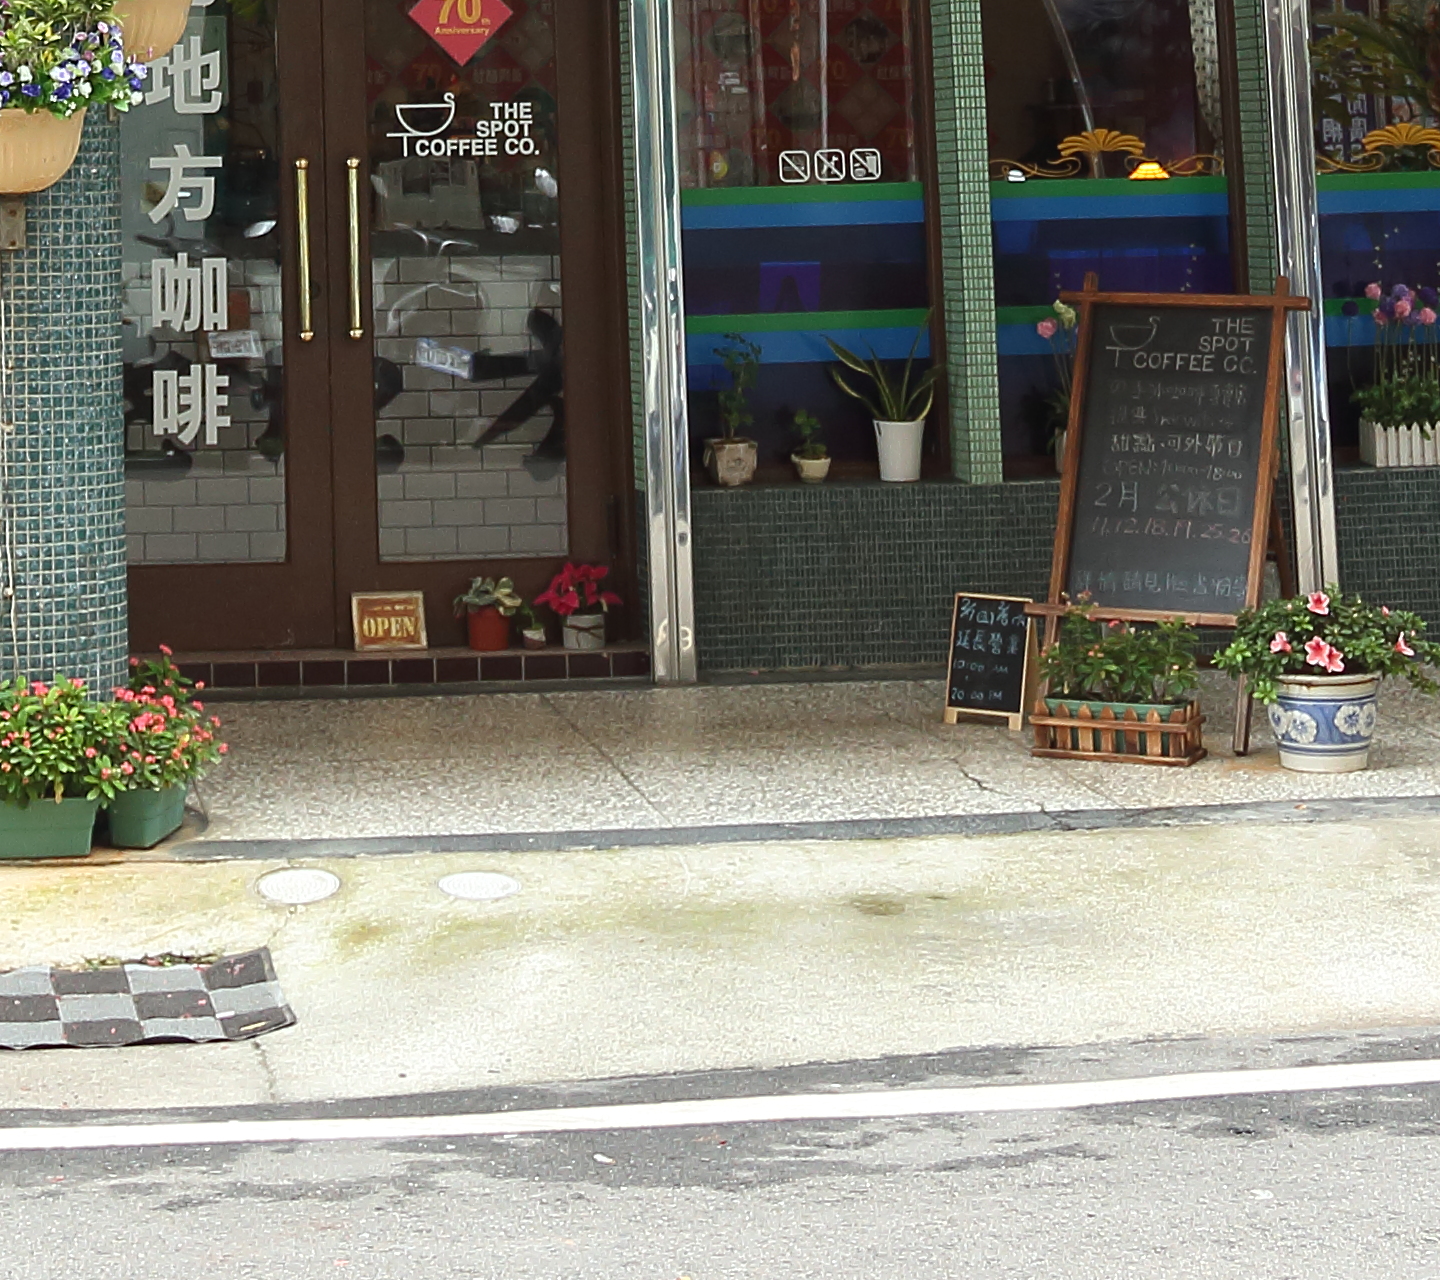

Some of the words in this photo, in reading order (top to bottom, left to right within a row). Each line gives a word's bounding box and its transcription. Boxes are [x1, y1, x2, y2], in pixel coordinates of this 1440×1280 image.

[434, 26, 490, 36] Anniversary
[489, 102, 532, 119] THE
[476, 120, 532, 137] SPOT
[415, 139, 498, 156] COFFEE
[504, 138, 540, 155] CO.
[1212, 317, 1255, 335] THE
[1199, 336, 1255, 353] SPOT
[1133, 351, 1216, 372] COFFEE
[362, 615, 416, 639] OPEN
